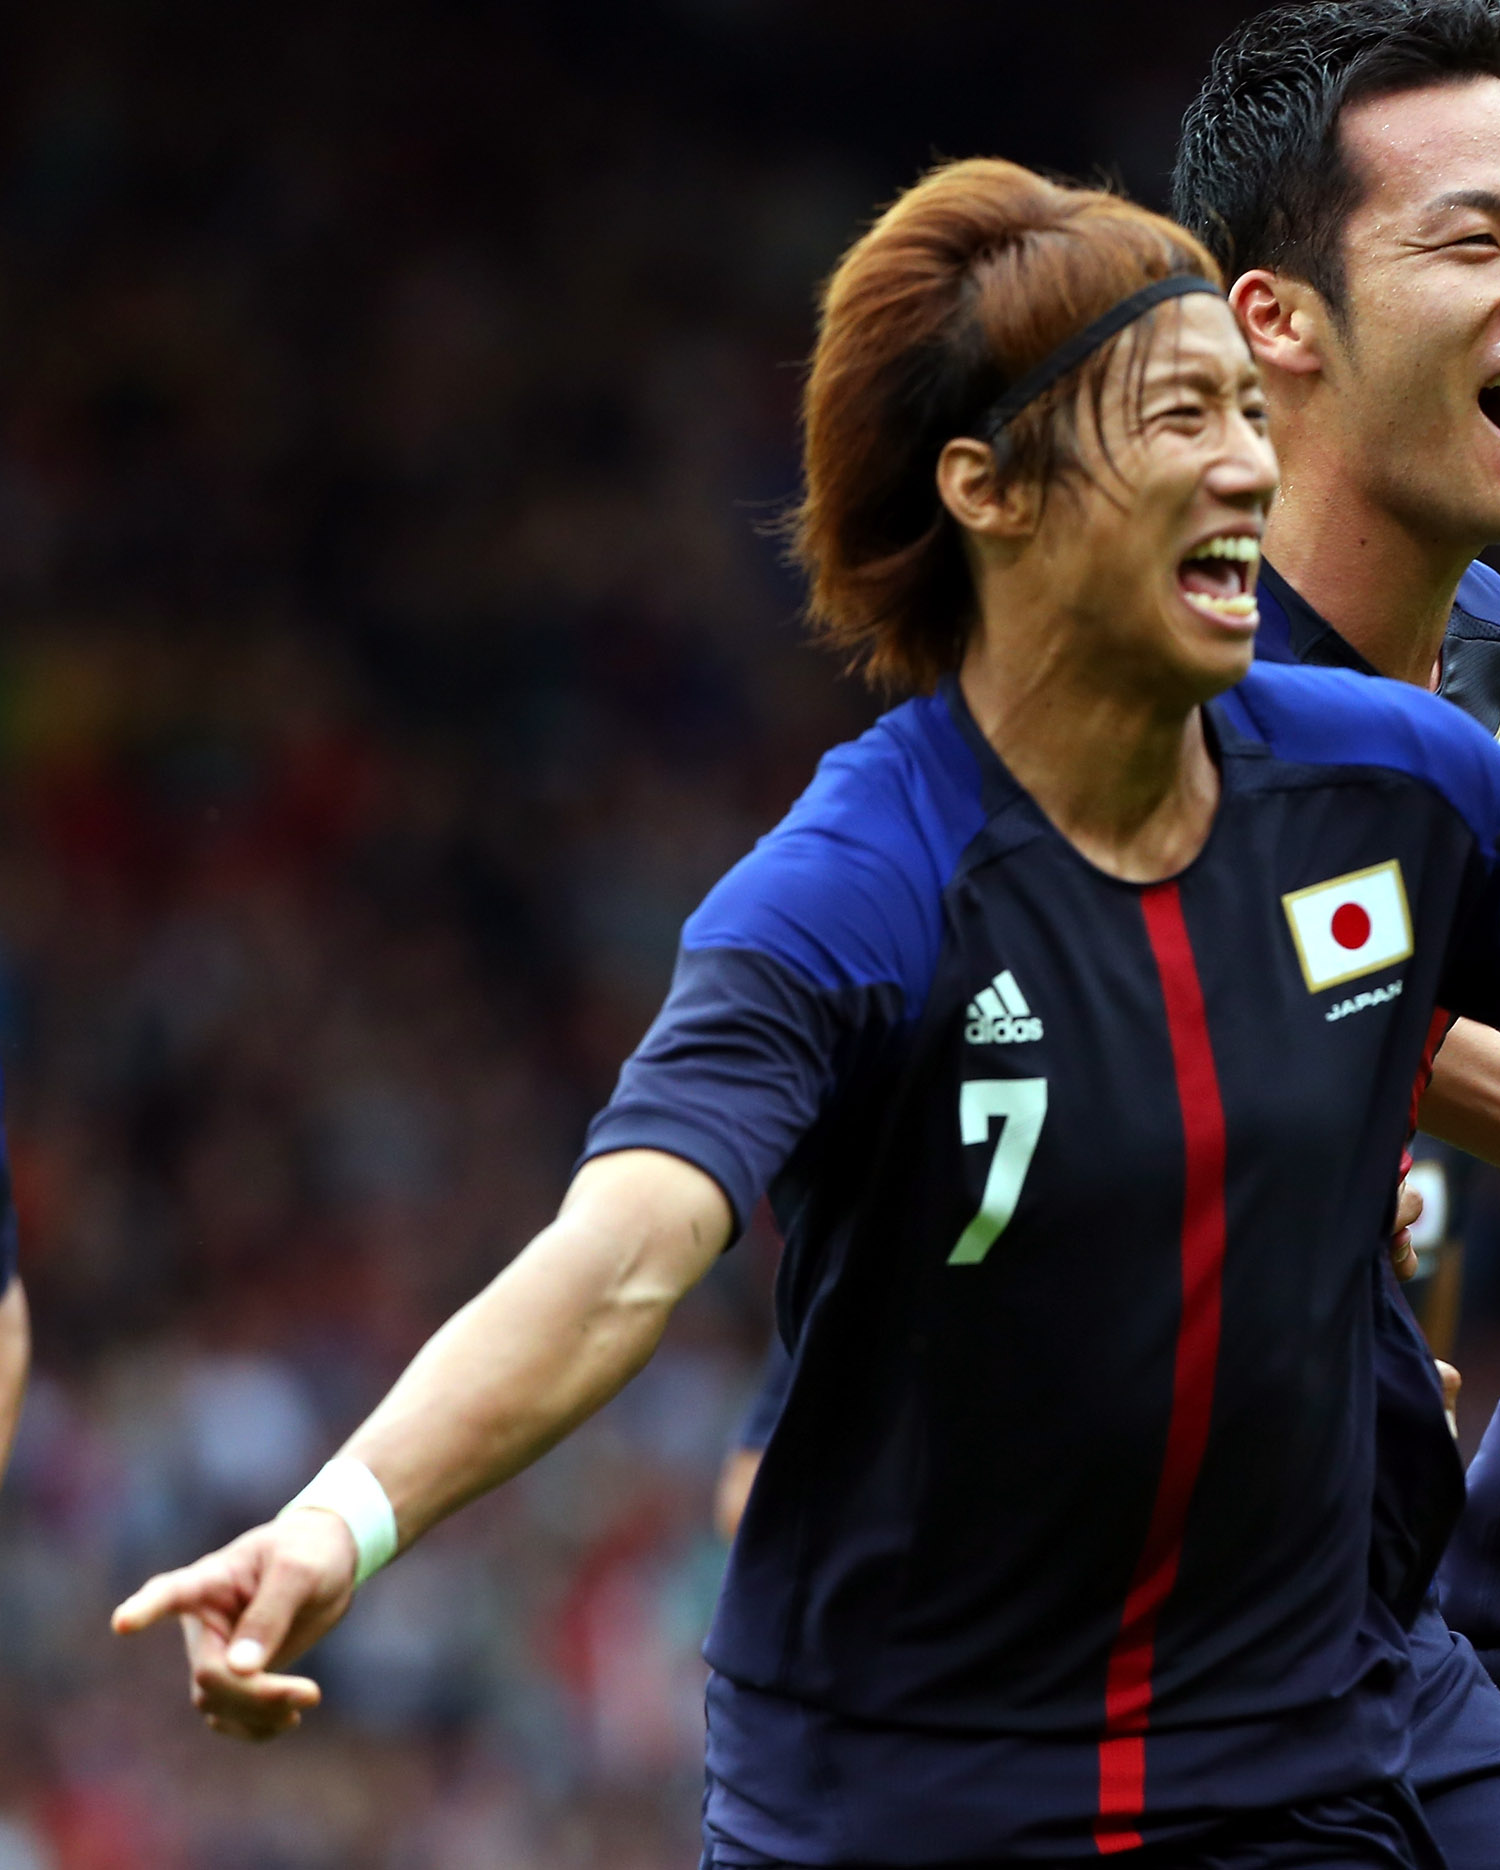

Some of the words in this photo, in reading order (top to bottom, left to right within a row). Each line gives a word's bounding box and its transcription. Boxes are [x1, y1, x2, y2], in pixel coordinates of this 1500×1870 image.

[1325, 979, 1403, 1022] JAPAN
[964, 1015, 1044, 1045] adidas
[947, 1076, 1048, 1265] 7
